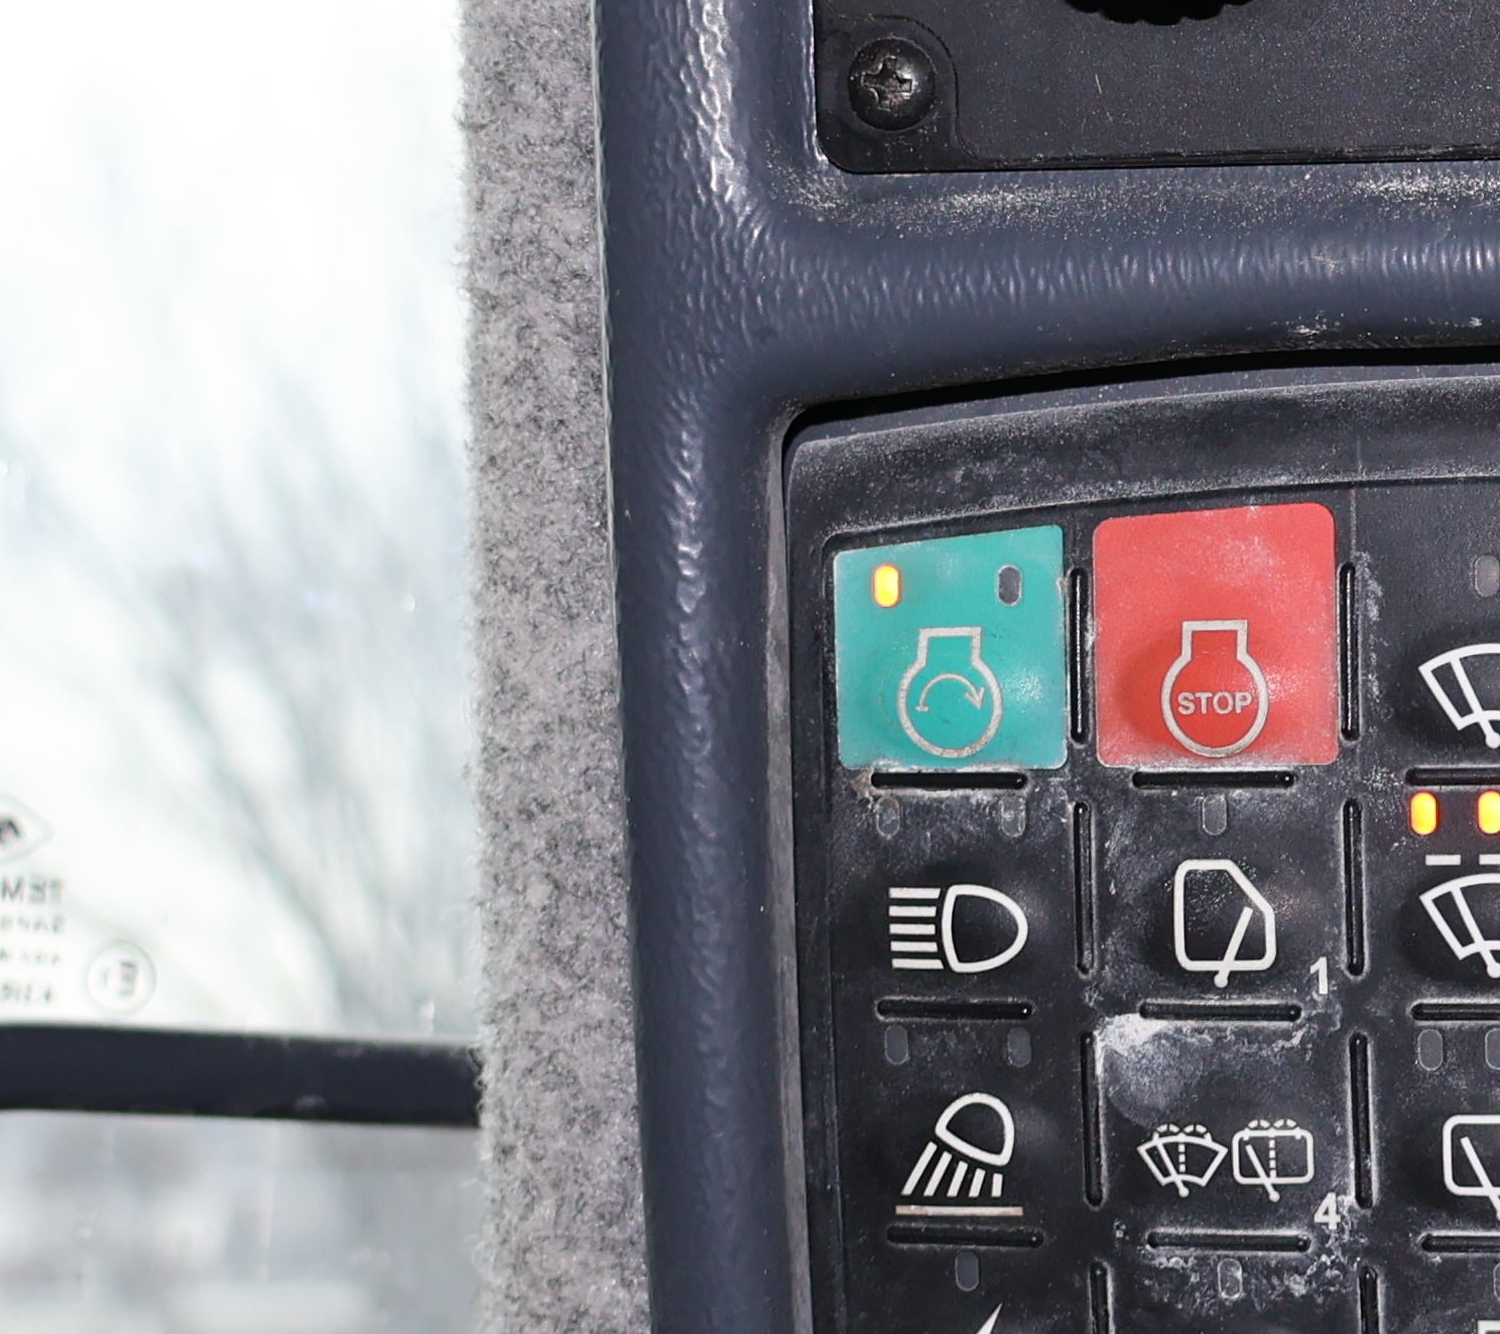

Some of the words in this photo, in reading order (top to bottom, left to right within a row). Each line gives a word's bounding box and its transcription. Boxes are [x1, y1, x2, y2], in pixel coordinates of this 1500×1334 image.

[1177, 689, 1253, 715] STOP
[1309, 956, 1329, 996] 1
[1313, 1192, 1342, 1230] 4
